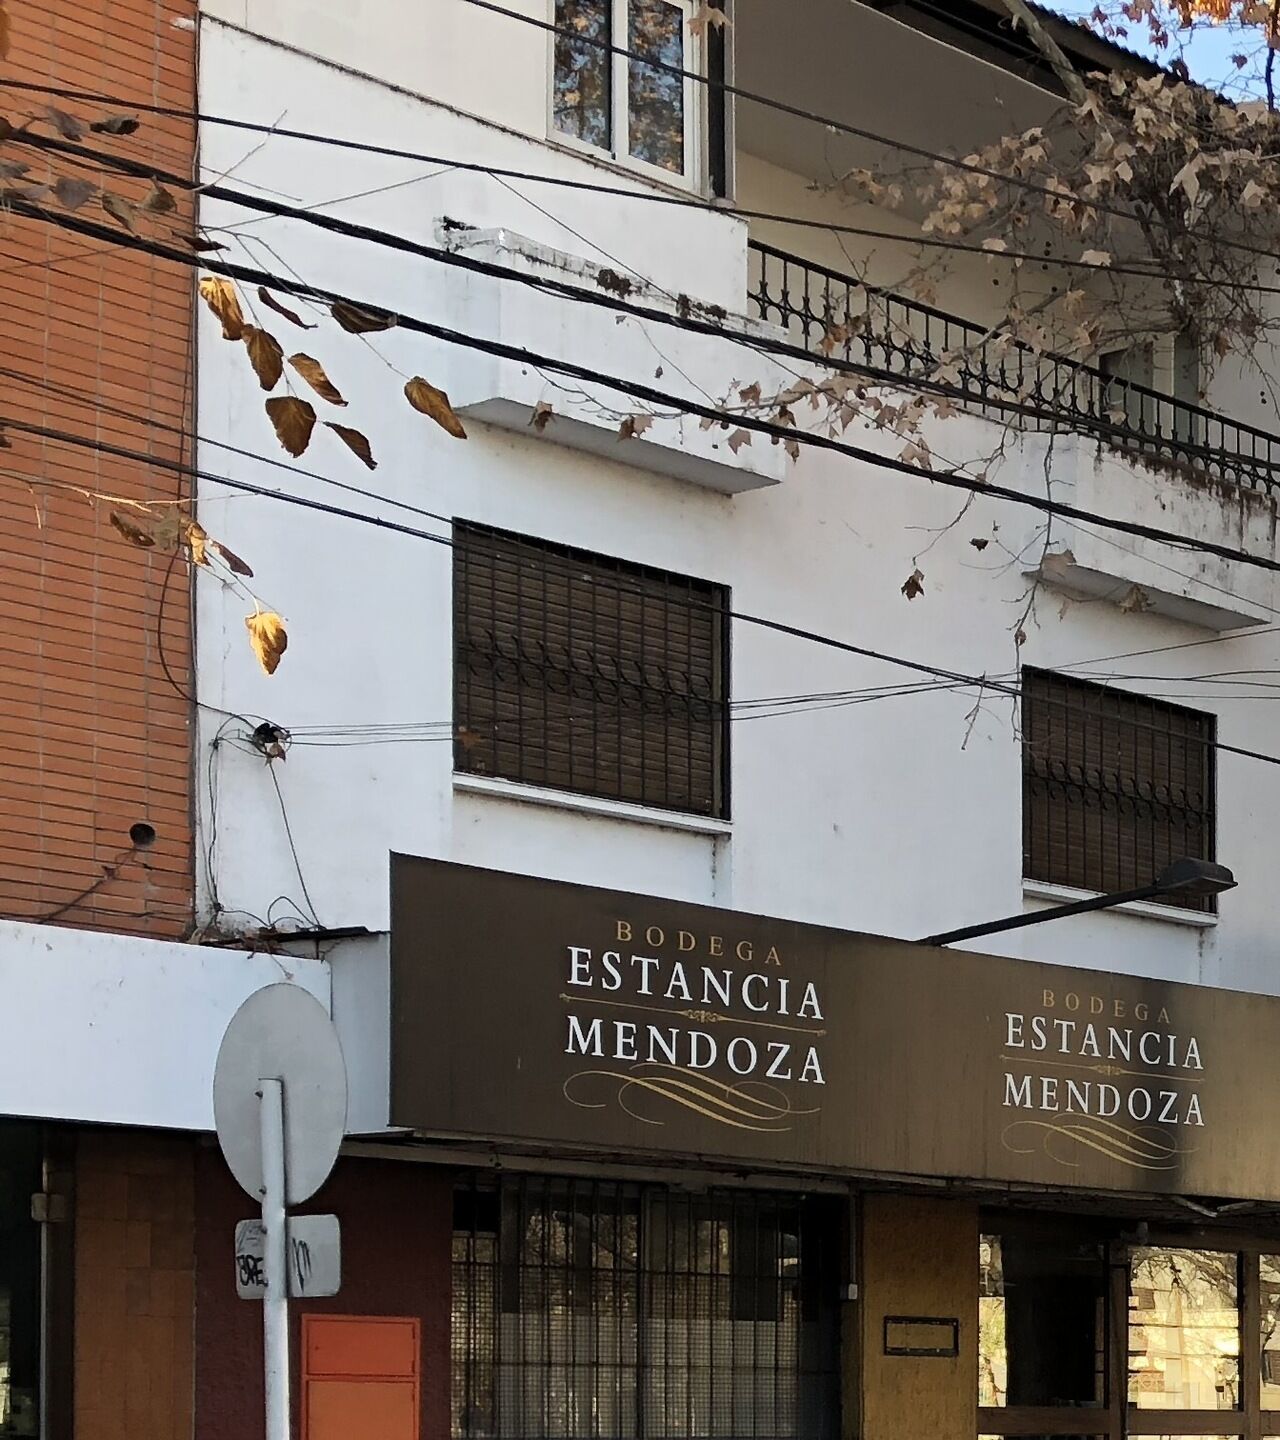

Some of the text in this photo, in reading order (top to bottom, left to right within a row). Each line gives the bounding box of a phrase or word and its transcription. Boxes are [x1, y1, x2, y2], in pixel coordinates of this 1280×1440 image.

[616, 920, 782, 967] BODEGA
[566, 945, 825, 1021] ESTANCIA
[1043, 989, 1171, 1024] BODEGA
[564, 1015, 826, 1085] MENDOZA
[1004, 1012, 1204, 1070] ESTANCIA
[1002, 1072, 1205, 1127] MENDOZA
